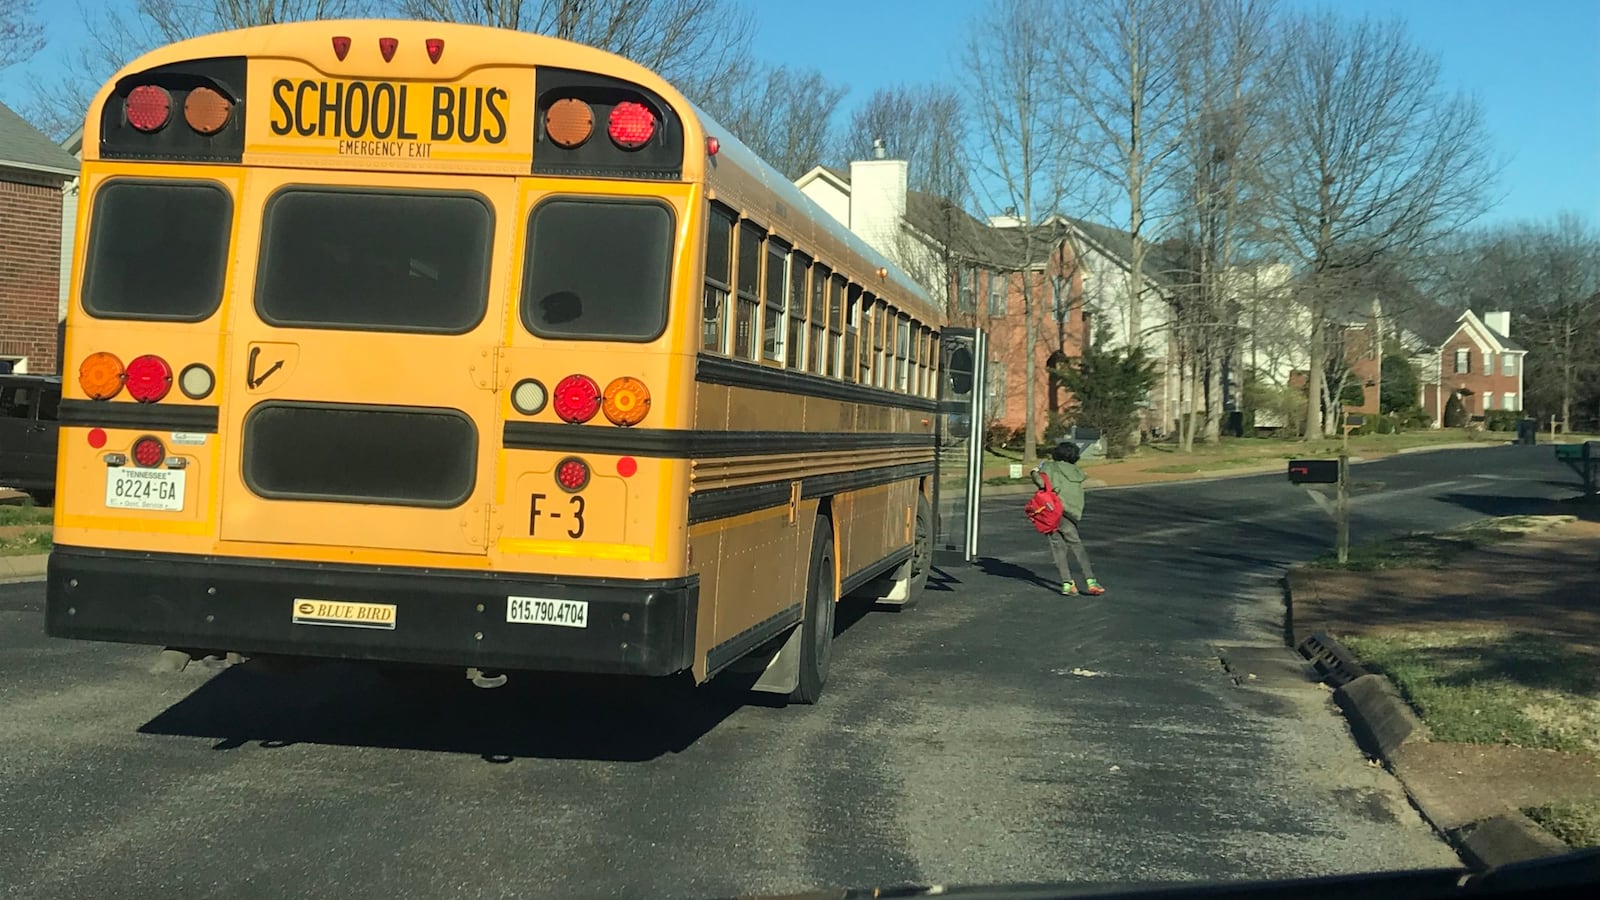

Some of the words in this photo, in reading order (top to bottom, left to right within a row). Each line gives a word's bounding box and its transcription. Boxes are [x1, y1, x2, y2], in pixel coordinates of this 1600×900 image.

[271, 79, 418, 140] SCHOOL
[431, 86, 507, 144] BUS
[339, 140, 403, 157] EMERGENCY
[409, 143, 432, 158] EXIT
[126, 471, 167, 480] TENNESSEE
[115, 478, 176, 500] 8224-GA
[317, 603, 354, 618] BLUE
[357, 606, 391, 621] BIRD
[511, 600, 584, 624] 615.790.4704
